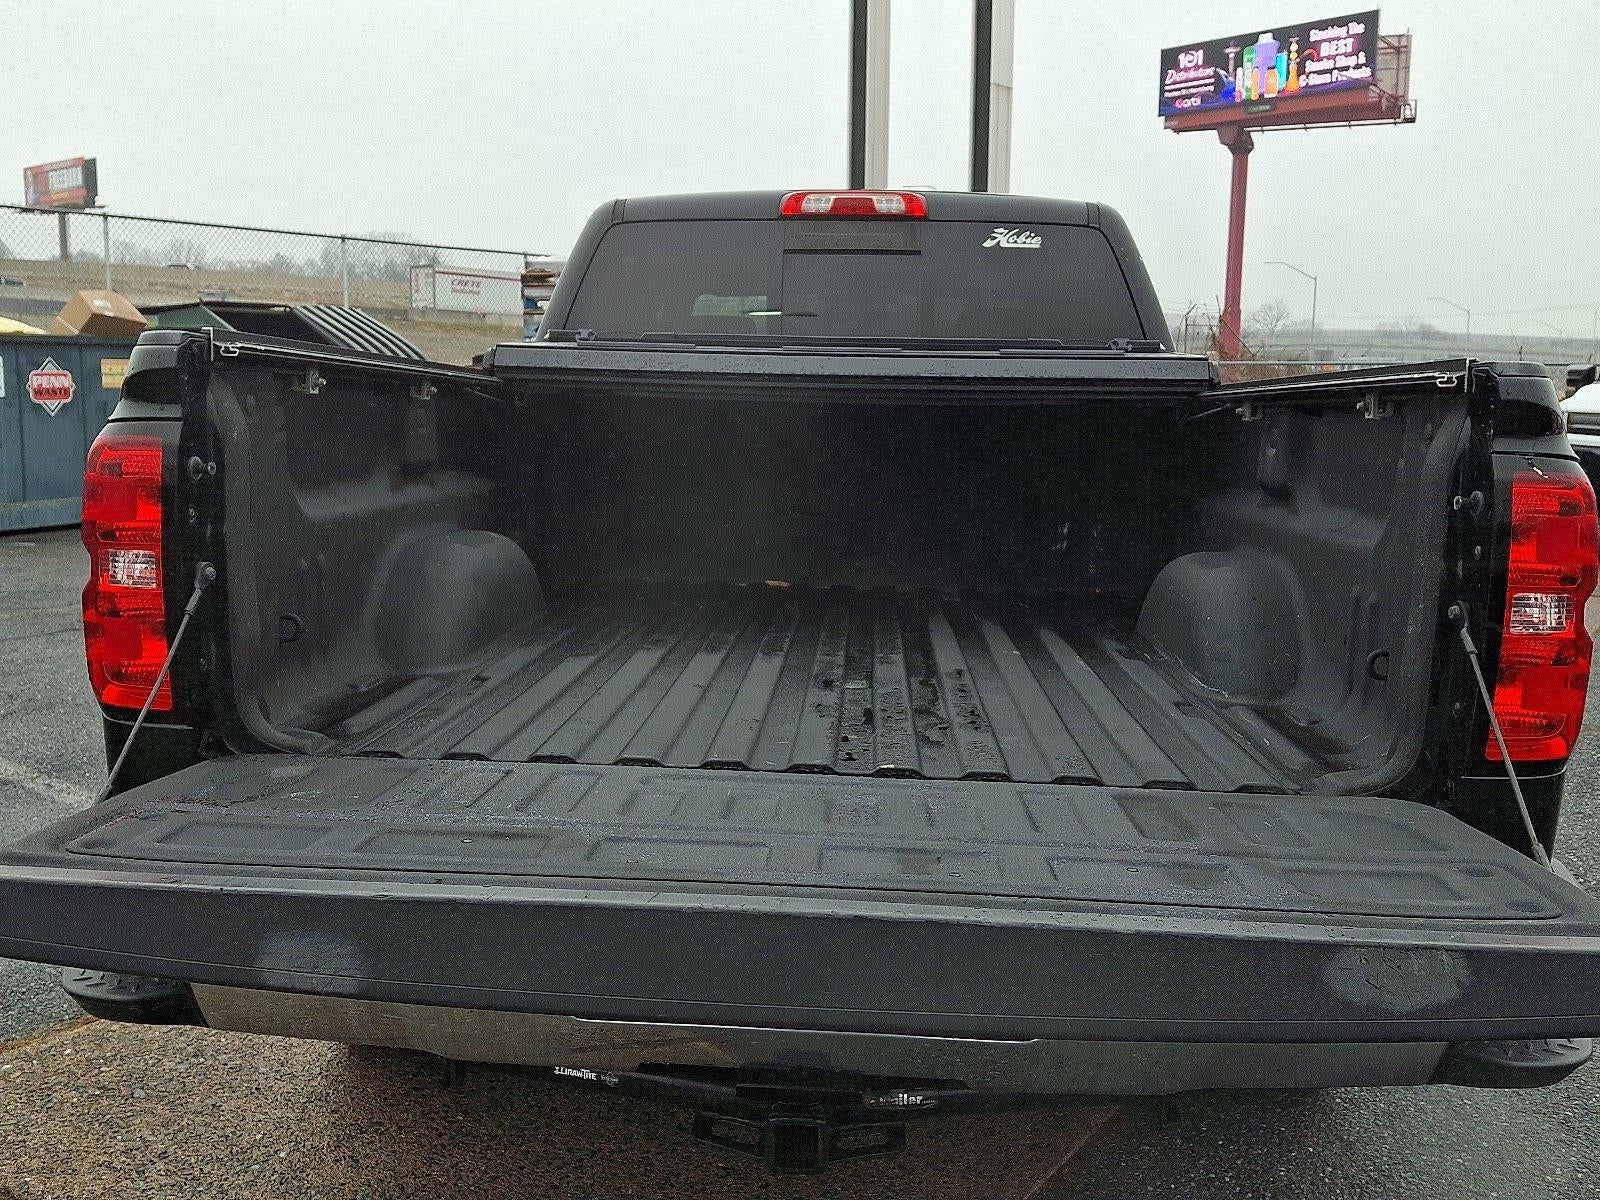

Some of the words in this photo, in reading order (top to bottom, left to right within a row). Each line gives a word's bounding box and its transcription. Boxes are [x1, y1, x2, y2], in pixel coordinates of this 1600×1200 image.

[1348, 22, 1365, 34] The
[1320, 38, 1355, 57] BEST
[1178, 50, 1204, 68] 101
[1335, 55, 1358, 67] Shop
[982, 227, 1042, 248] Hobie
[451, 279, 482, 288] CRETE
[32, 374, 68, 388] PENN
[33, 387, 69, 397] WASTE
